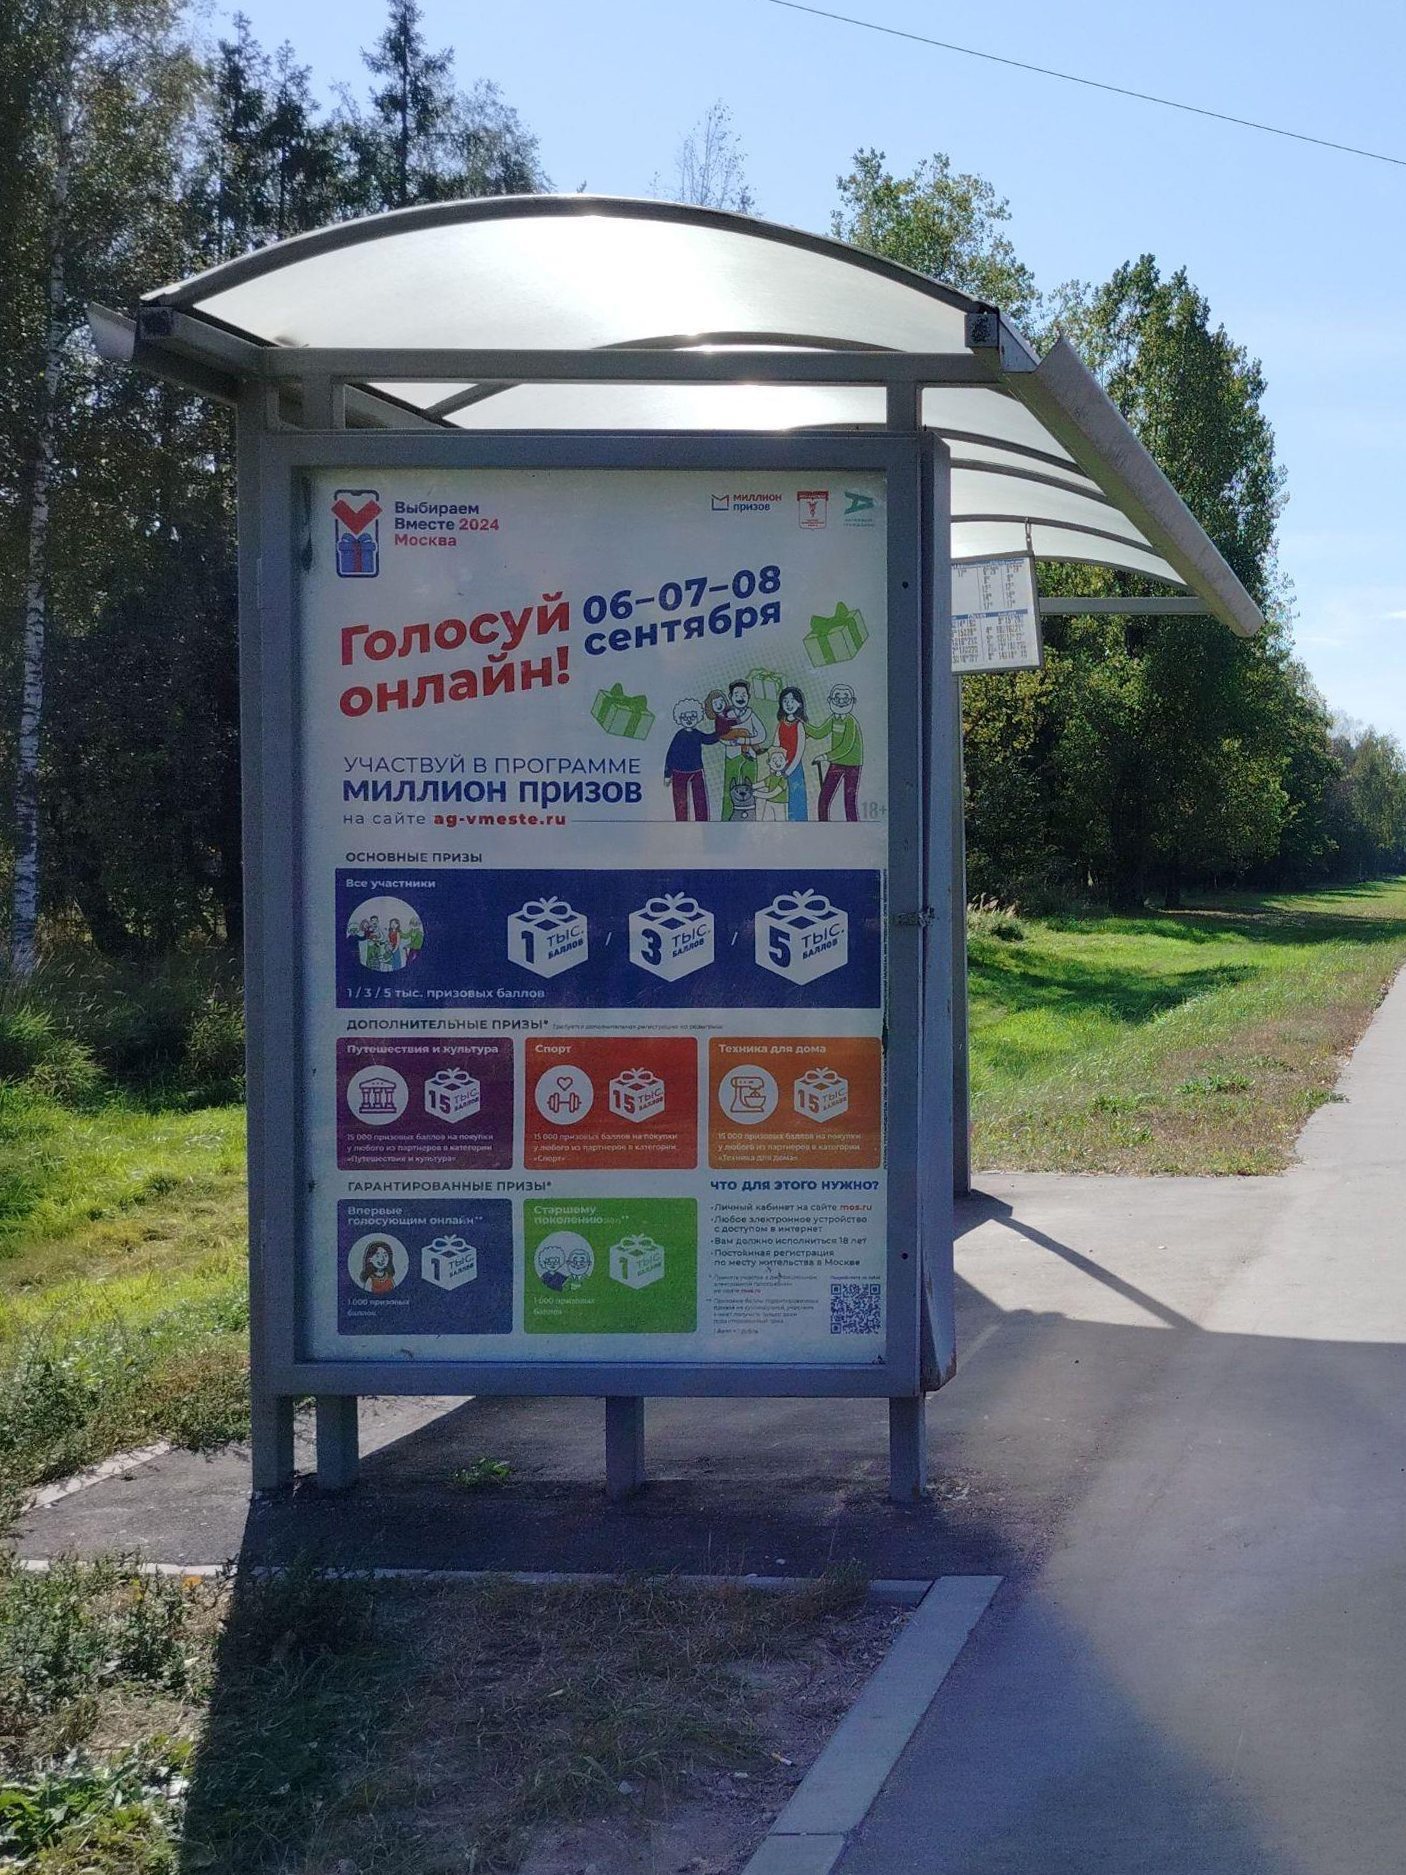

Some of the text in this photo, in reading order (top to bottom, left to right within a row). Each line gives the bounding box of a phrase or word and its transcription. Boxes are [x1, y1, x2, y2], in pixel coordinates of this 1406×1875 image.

[395, 502, 479, 517] Выбираем
[733, 503, 770, 512] призов
[395, 518, 499, 530] Вместе 2024
[395, 534, 456, 546] Москва
[341, 591, 570, 665] Голосуй
[584, 600, 781, 655] сентября
[339, 646, 570, 717] онлайн!
[345, 754, 640, 774] УЧАСТВУЙ В ПРОГРАММЕ
[519, 781, 642, 809] призов
[862, 802, 887, 818] 18+
[343, 812, 566, 827] на сайте ag-vmeste.ru
[346, 852, 482, 863] ОСНОВНЫЕ ПРИЗЫ
[346, 879, 436, 889] Все участники
[521, 930, 534, 964] 1
[548, 938, 583, 960] БАЛЛОВ
[641, 928, 661, 966] 3
[672, 938, 704, 957] БАЛЛОВ
[769, 926, 790, 968] 5
[802, 939, 838, 959] БАЛЛОВ
[347, 989, 352, 998] 1
[364, 989, 372, 998] 3
[384, 988, 391, 998] 5
[395, 990, 423, 998] тыс.
[427, 990, 493, 1001] призовых
[497, 988, 545, 998] баллов
[347, 1020, 487, 1031] ДОПОЛНИТЕЛЬНЫЕ
[347, 1045, 429, 1055] Путешествия
[444, 1046, 498, 1055] культура
[535, 1045, 571, 1055] Спорт
[718, 1044, 767, 1053] Техника
[770, 1045, 792, 1053] для
[429, 1091, 451, 1113] 15
[613, 1090, 635, 1113] 15
[798, 1090, 820, 1113] 15
[348, 1182, 492, 1191] ГАРАНТИРОВАННЫЕ
[711, 1181, 879, 1191] ЧТО ДЛЯ ЭТОГО НУЖНО?
[348, 1207, 402, 1216] Впервые
[534, 1206, 596, 1214] Старшему
[714, 1203, 752, 1211] Личный
[348, 1218, 426, 1226] голосующим
[813, 1216, 867, 1225] устройство
[722, 1226, 767, 1234] доступом
[774, 1250, 834, 1258] регистрация
[619, 1257, 628, 1280] 1
[825, 1258, 860, 1266] Москве
[431, 1258, 440, 1281] 1
